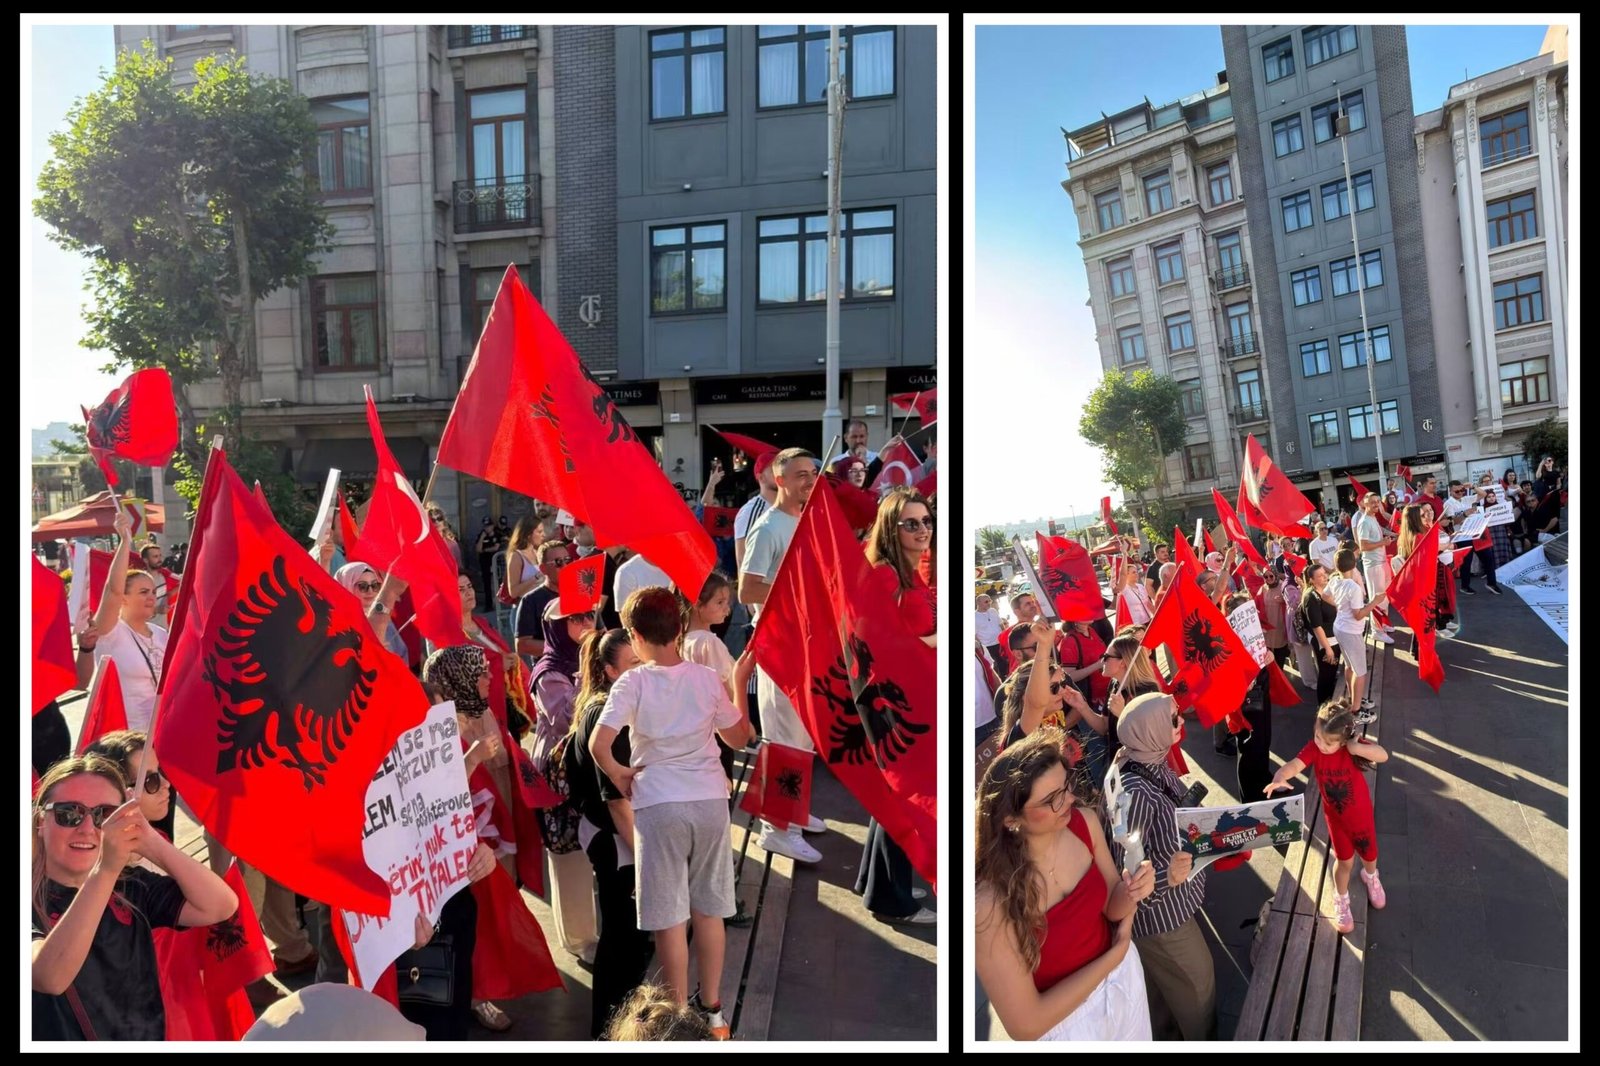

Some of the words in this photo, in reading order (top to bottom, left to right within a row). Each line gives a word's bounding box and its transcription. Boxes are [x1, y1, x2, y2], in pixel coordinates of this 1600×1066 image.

[614, 390, 642, 399] TIMES
[403, 728, 424, 755] se
[362, 794, 397, 840] LEM
[451, 813, 475, 839] ta
